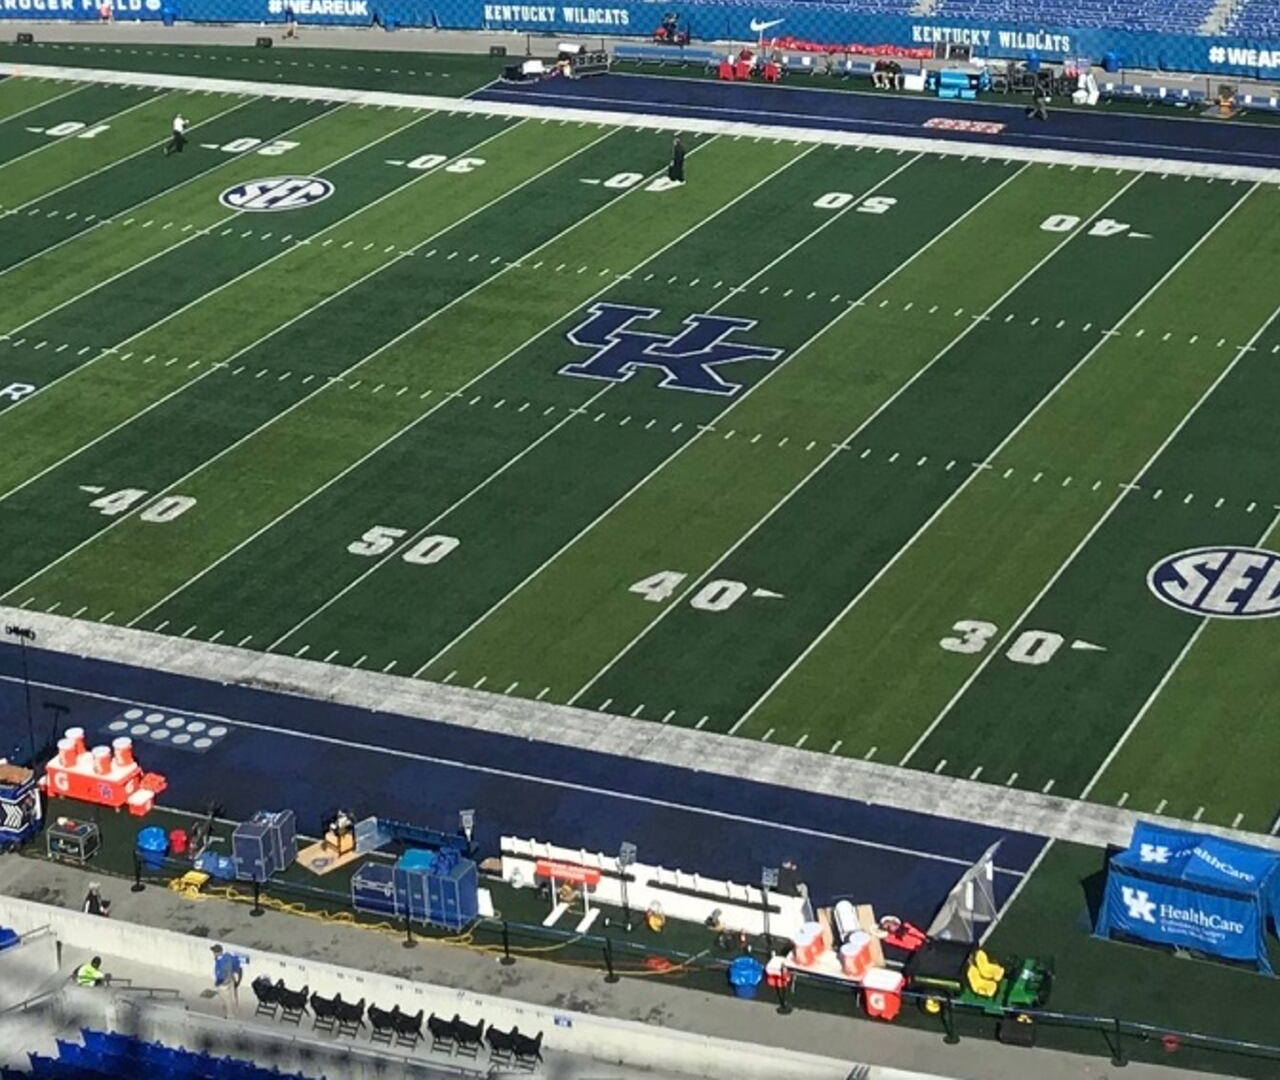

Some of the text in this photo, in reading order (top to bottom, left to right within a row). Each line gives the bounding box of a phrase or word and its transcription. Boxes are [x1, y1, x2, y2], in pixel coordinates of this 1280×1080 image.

[484, 4, 629, 25] KENTUCKY WILDCATS
[912, 26, 1071, 52] KENTUCKY WILDCATS
[812, 192, 897, 214] 50
[558, 302, 785, 397] UK
[87, 488, 197, 524] 40
[347, 526, 461, 565] 50
[627, 570, 748, 613] 40
[939, 619, 1066, 666] 30
[54, 772, 69, 791] G
[1121, 886, 1157, 925] UK
[1160, 904, 1245, 935] HealthCare
